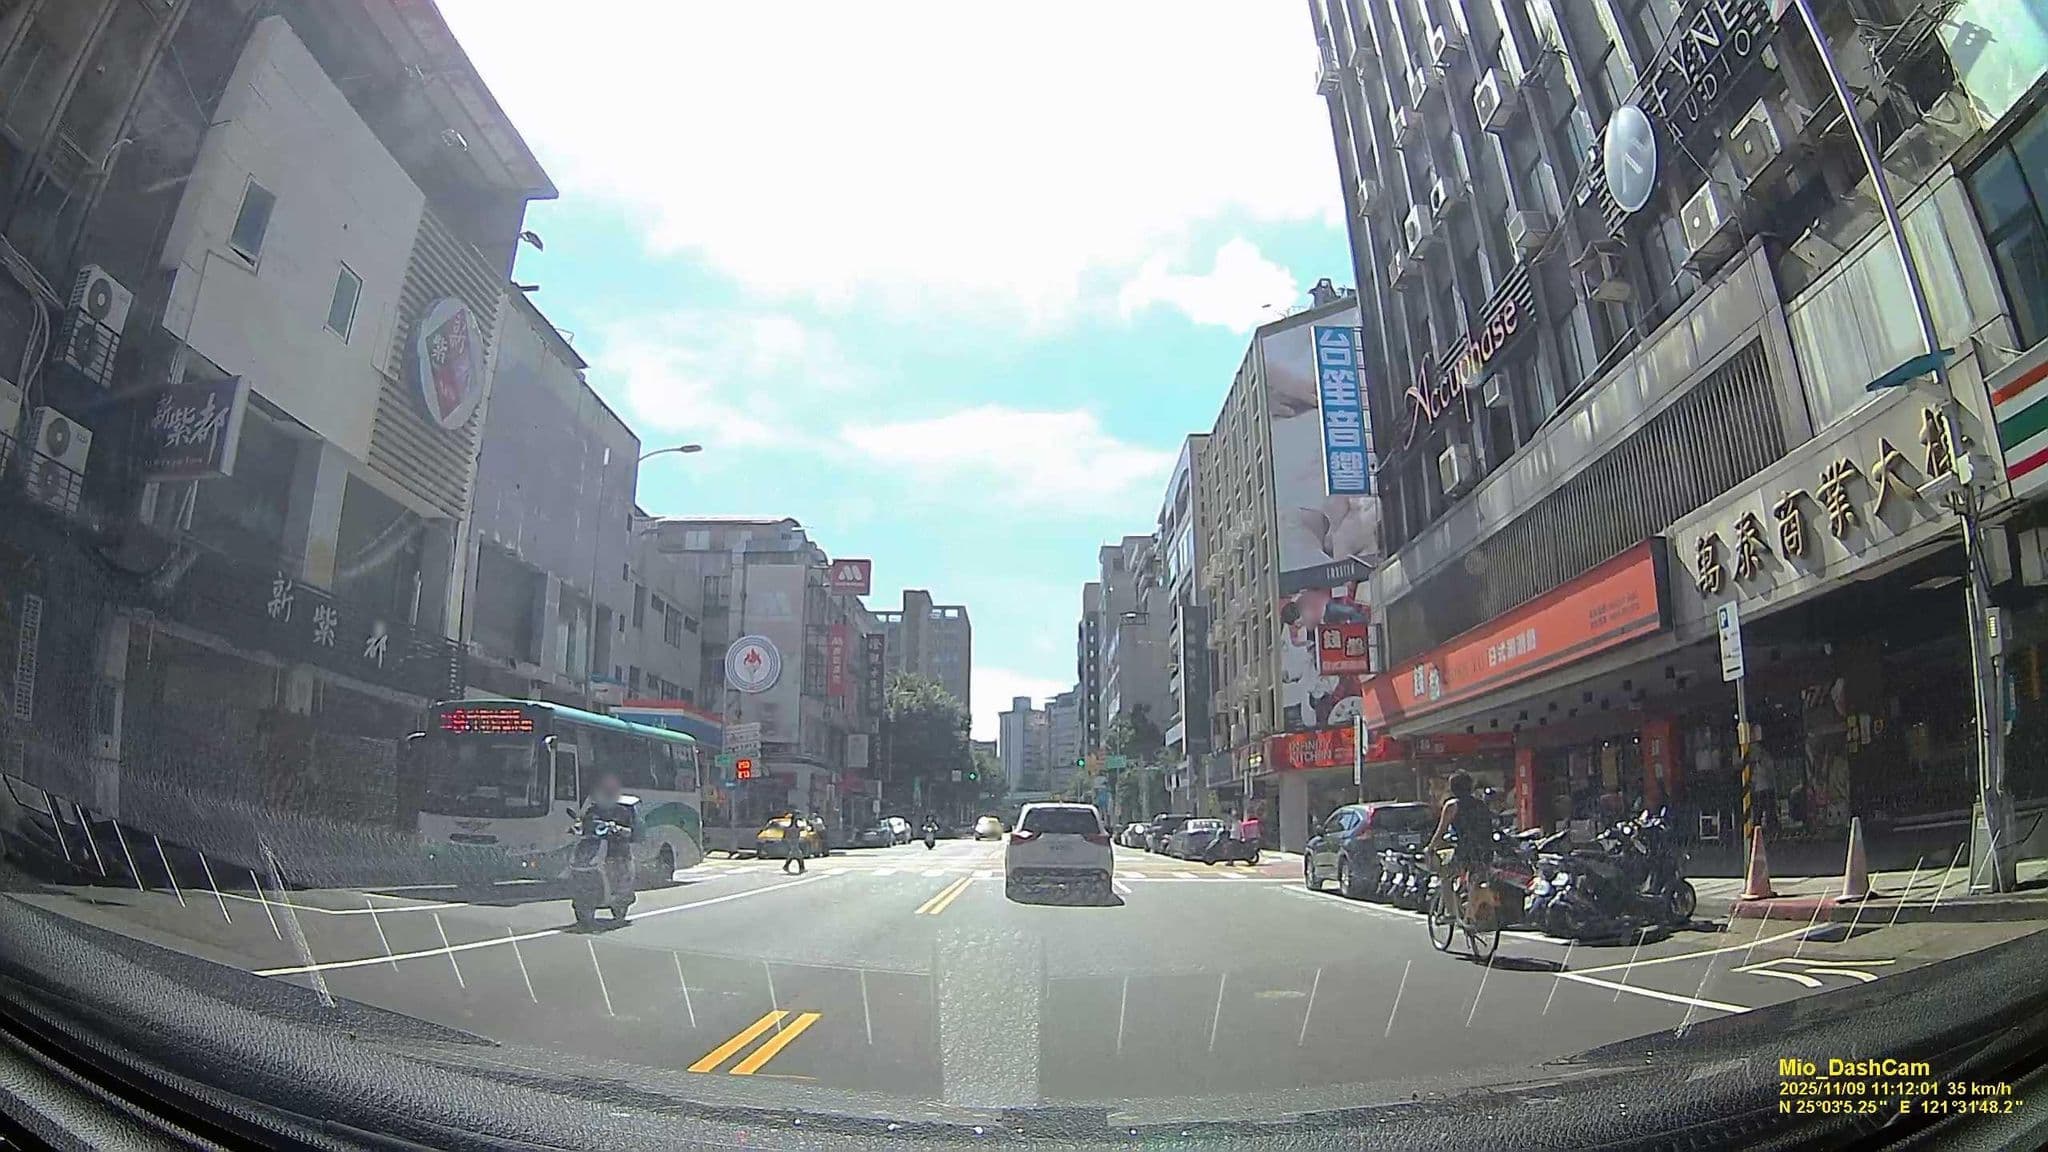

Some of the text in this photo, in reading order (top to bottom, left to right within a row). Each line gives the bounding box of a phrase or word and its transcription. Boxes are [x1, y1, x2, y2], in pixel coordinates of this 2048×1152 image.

[1665, 29, 1751, 144] AUDIO
[1319, 329, 1366, 491] 台笙音響
[1404, 299, 1518, 450] Accuphase
[152, 392, 229, 465] 新紫都
[267, 570, 388, 668] 新紫都
[1289, 749, 1332, 763] KITCHEN
